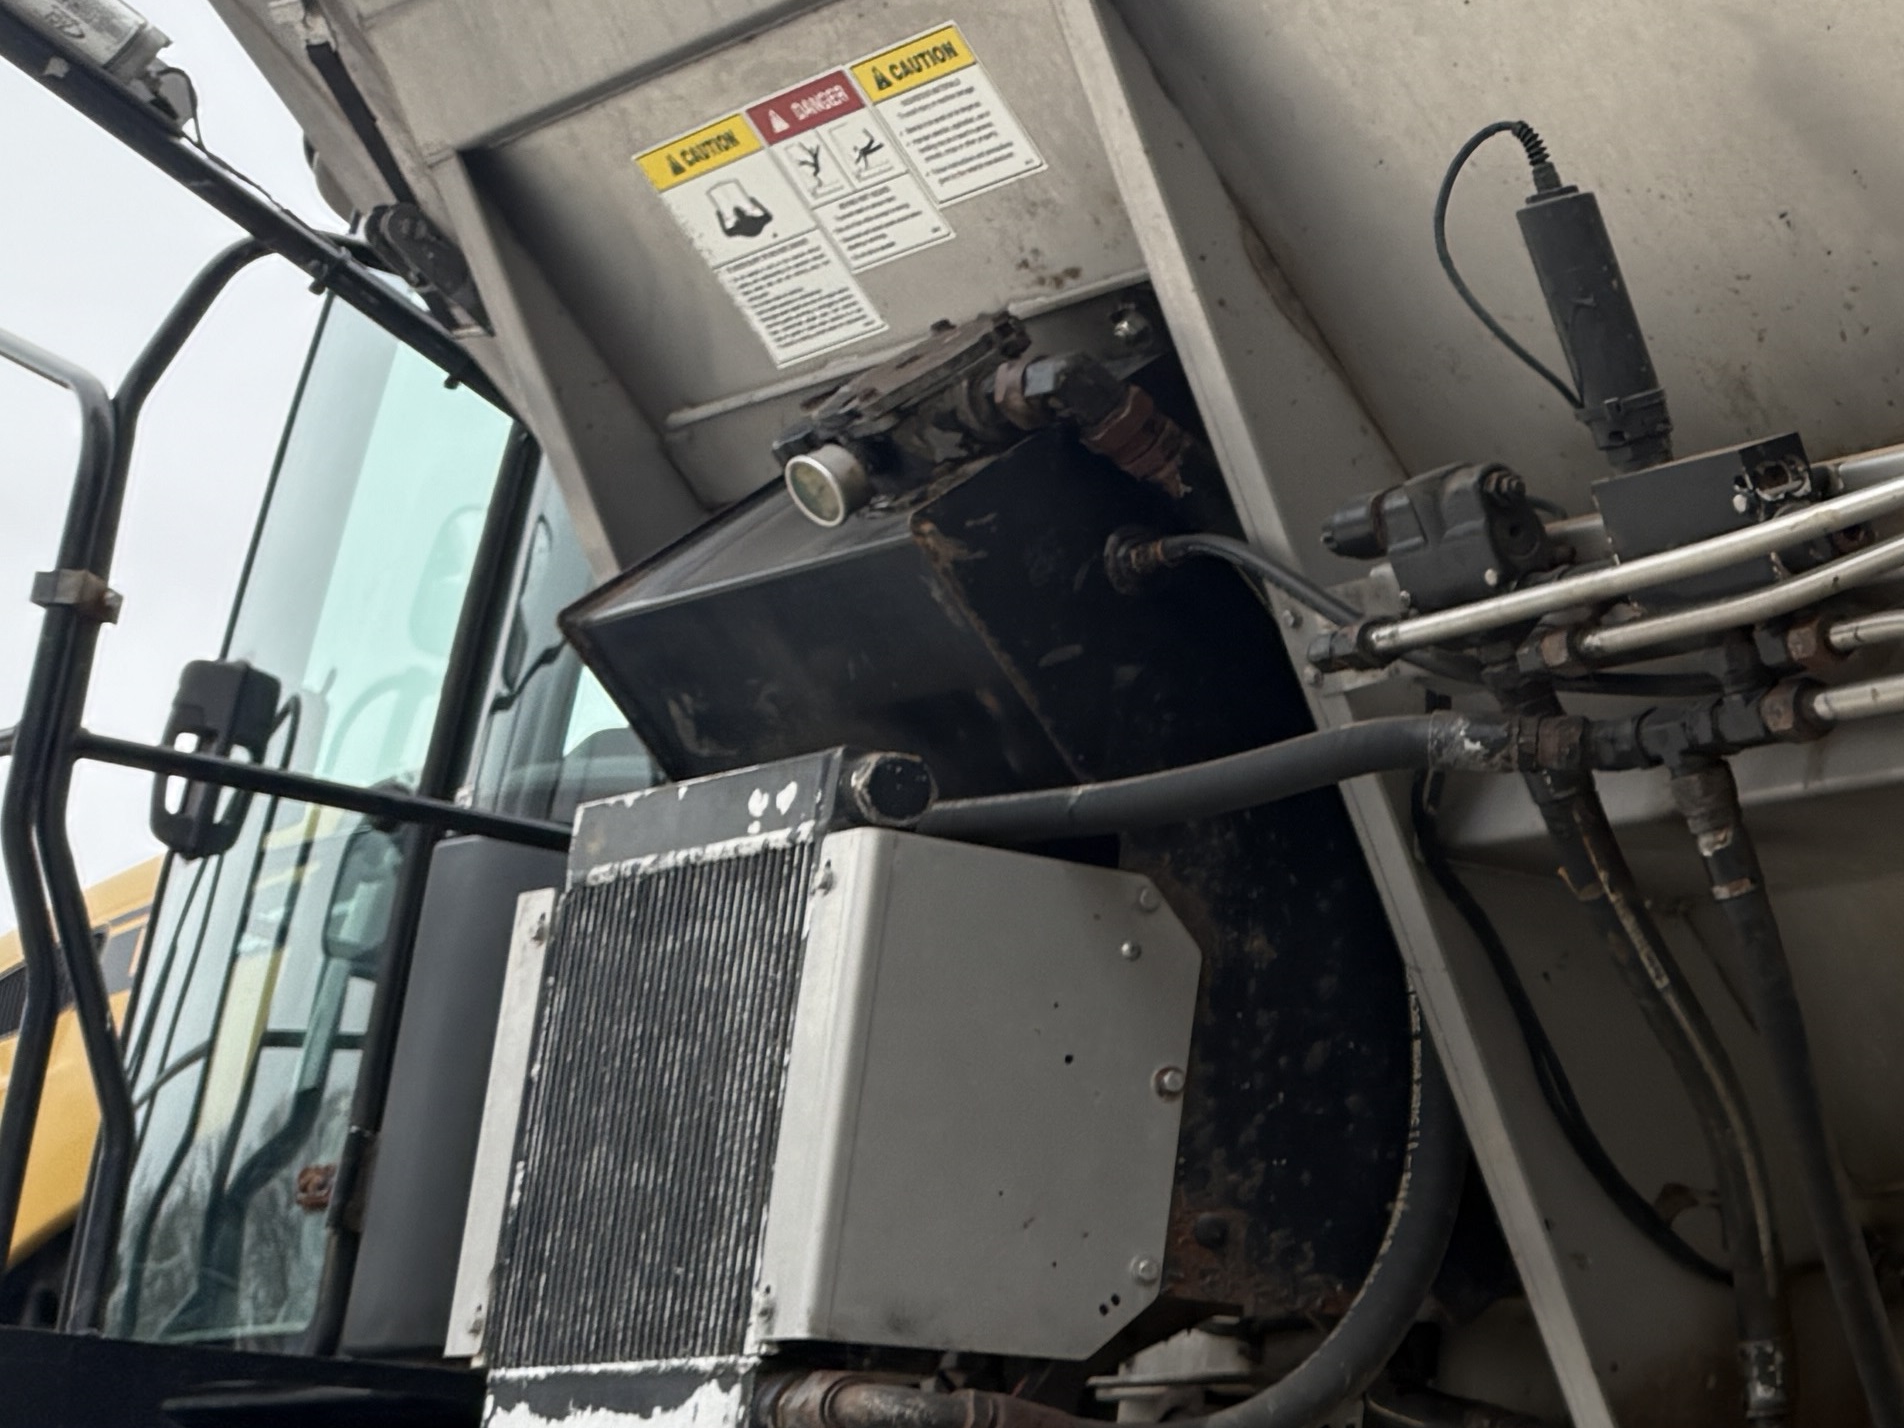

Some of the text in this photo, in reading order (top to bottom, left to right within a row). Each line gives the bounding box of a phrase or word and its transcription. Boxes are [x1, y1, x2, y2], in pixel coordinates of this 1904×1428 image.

[888, 40, 959, 81] CAUTION
[790, 84, 849, 121] DANGER
[682, 129, 740, 168] CAUTION
